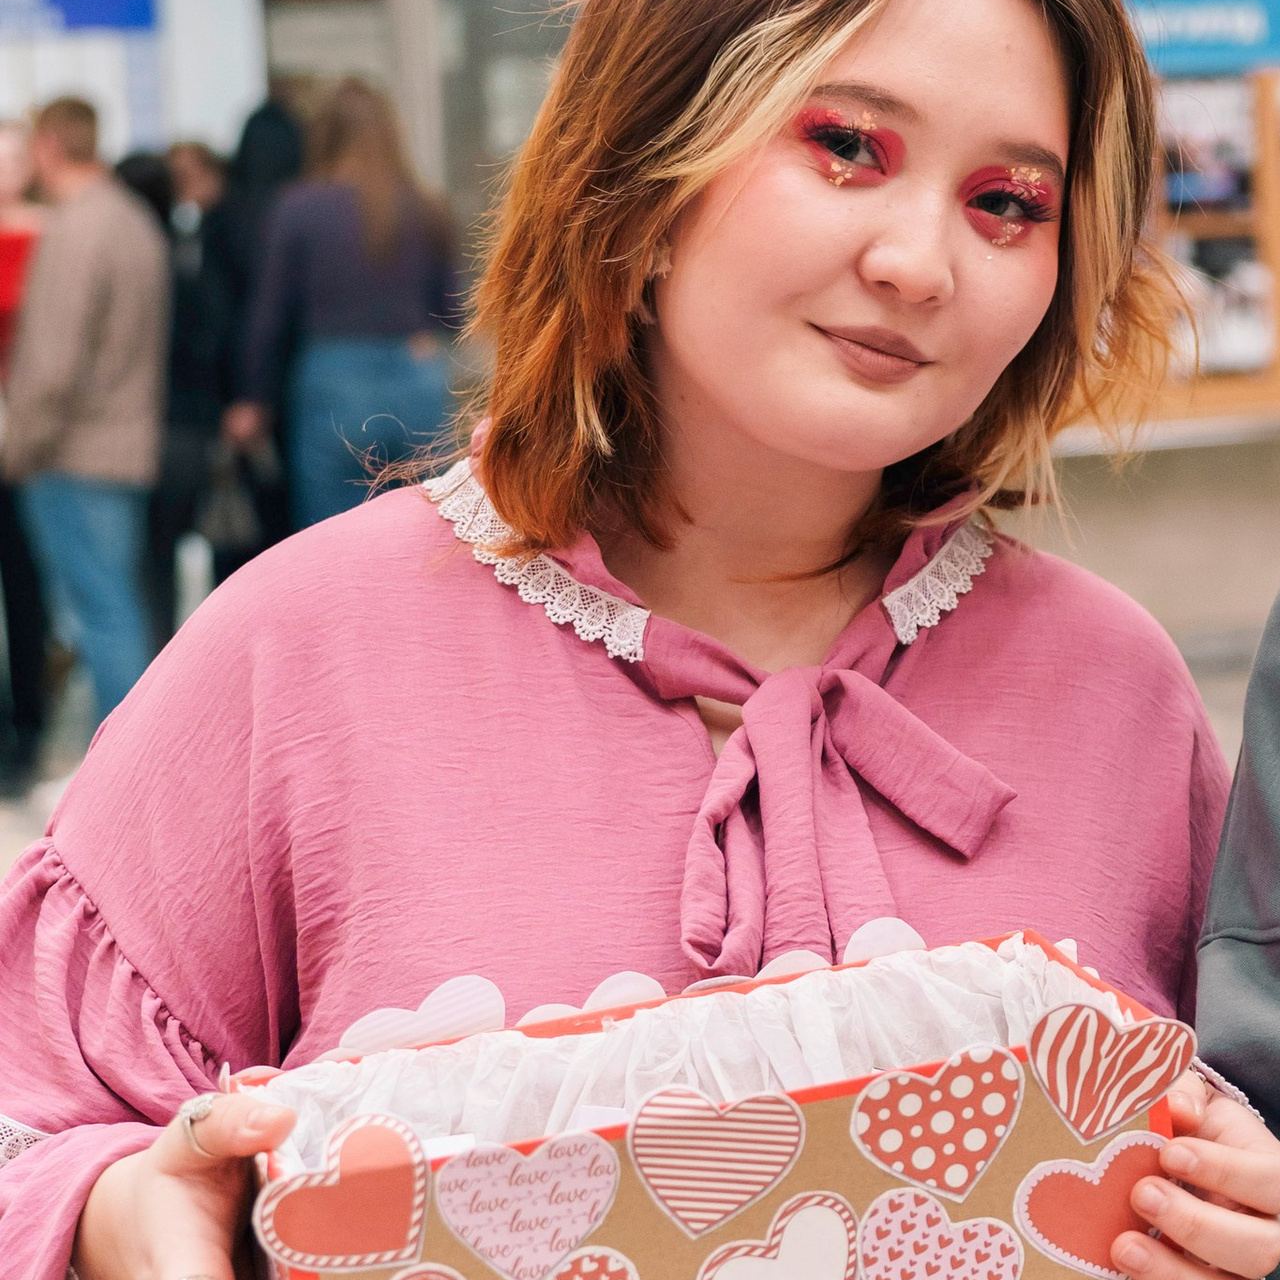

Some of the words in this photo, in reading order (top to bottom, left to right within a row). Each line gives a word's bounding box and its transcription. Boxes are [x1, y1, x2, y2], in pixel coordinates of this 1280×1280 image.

[466, 1149, 508, 1169] love
[547, 1142, 589, 1160] love
[508, 1162, 551, 1187] love
[469, 1189, 511, 1214] love
[548, 1180, 590, 1206] love
[509, 1208, 550, 1233] love
